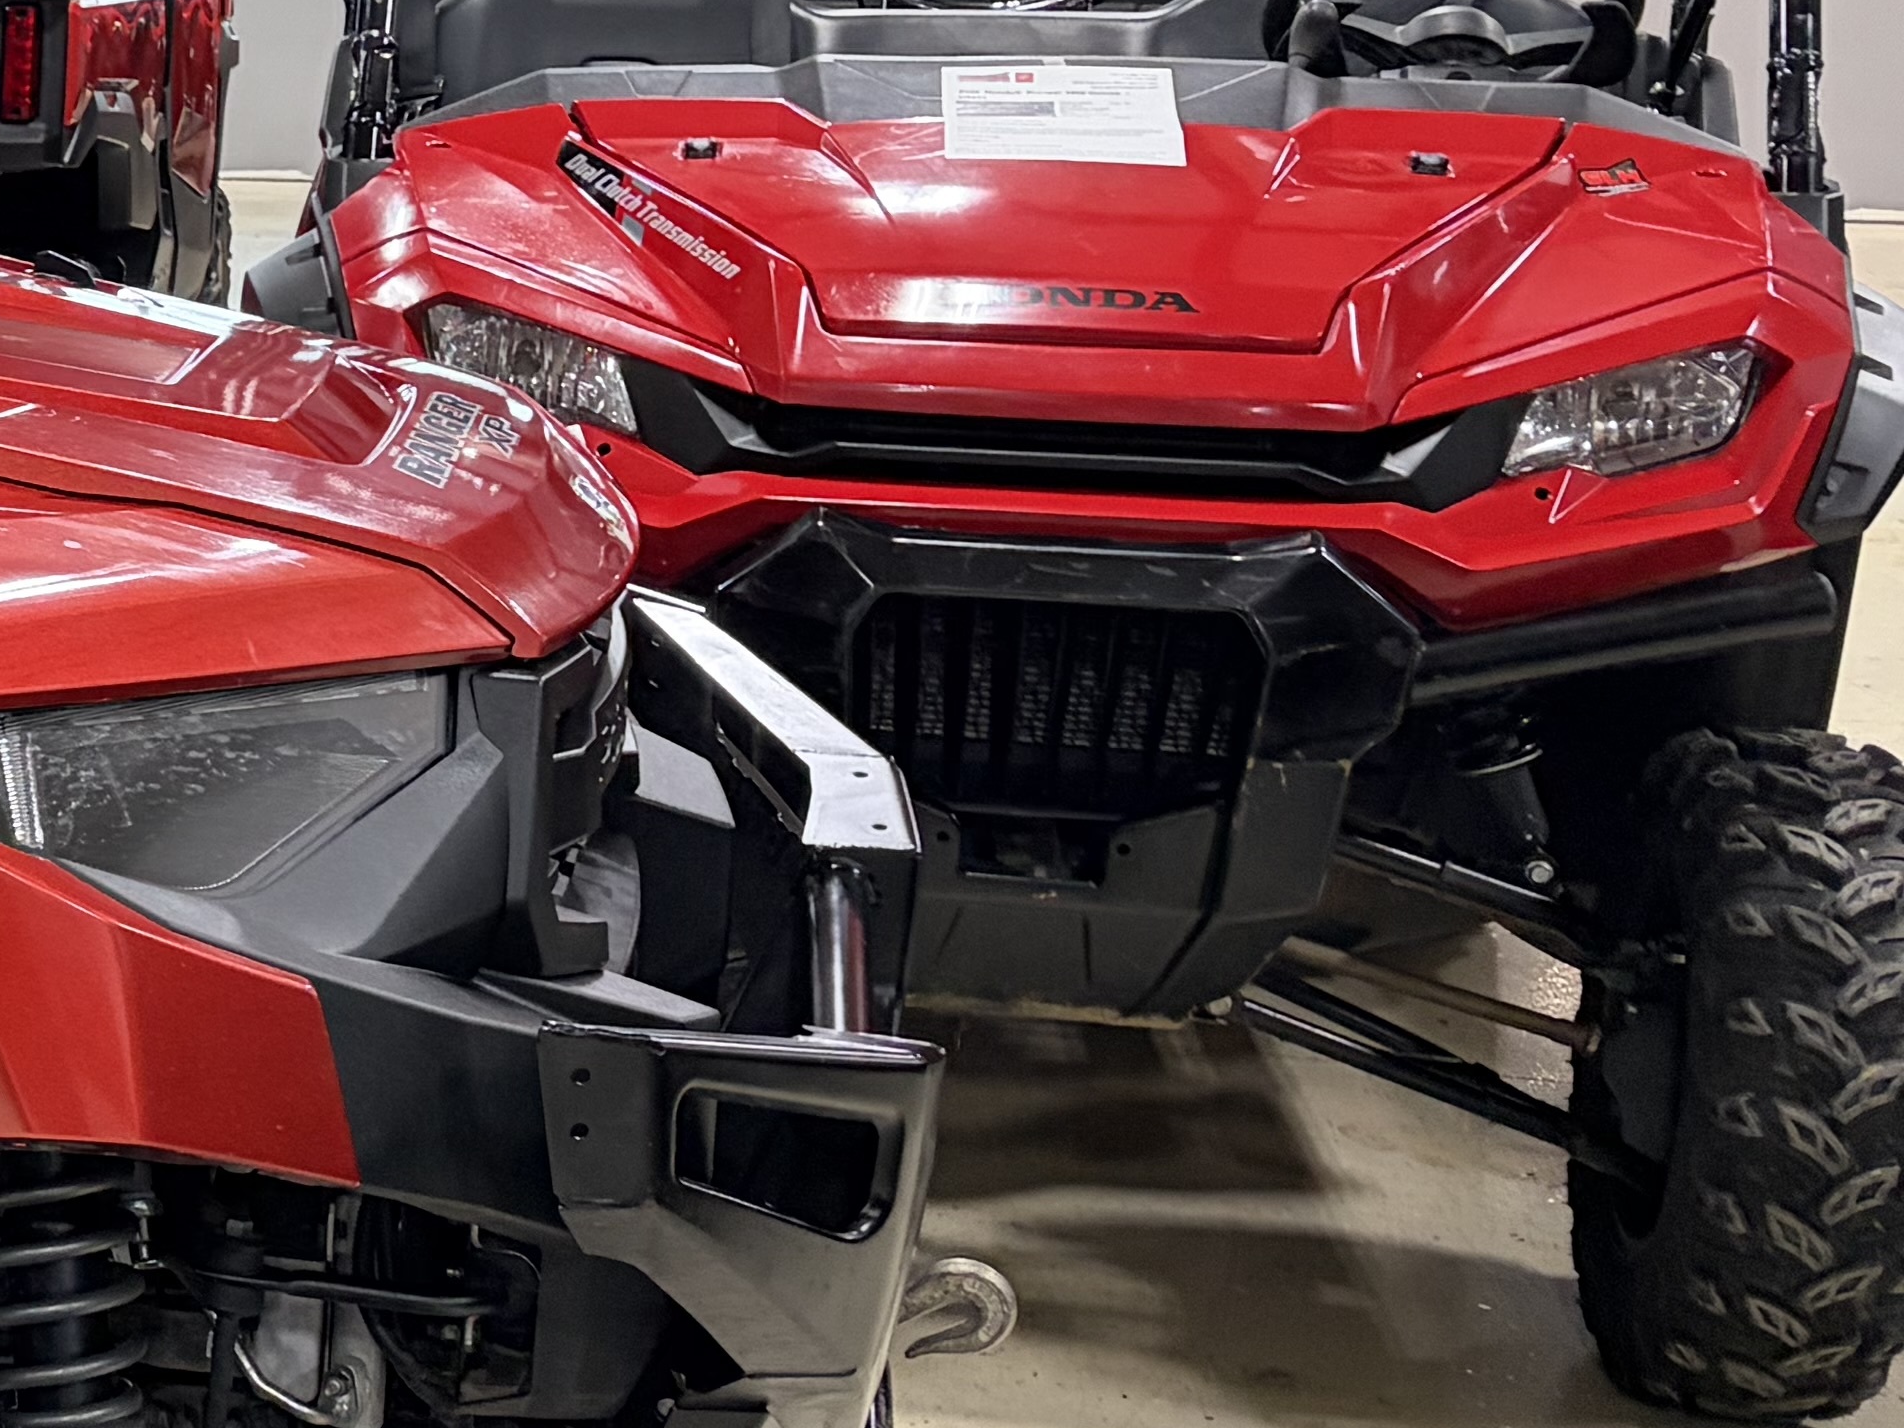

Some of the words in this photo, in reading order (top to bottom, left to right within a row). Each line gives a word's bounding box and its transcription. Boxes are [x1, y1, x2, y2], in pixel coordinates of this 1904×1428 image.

[564, 153, 606, 183] Dual
[594, 173, 643, 213] Clutch
[636, 200, 742, 280] Transmission
[392, 391, 485, 489] RANGER
[478, 414, 522, 459] XP
